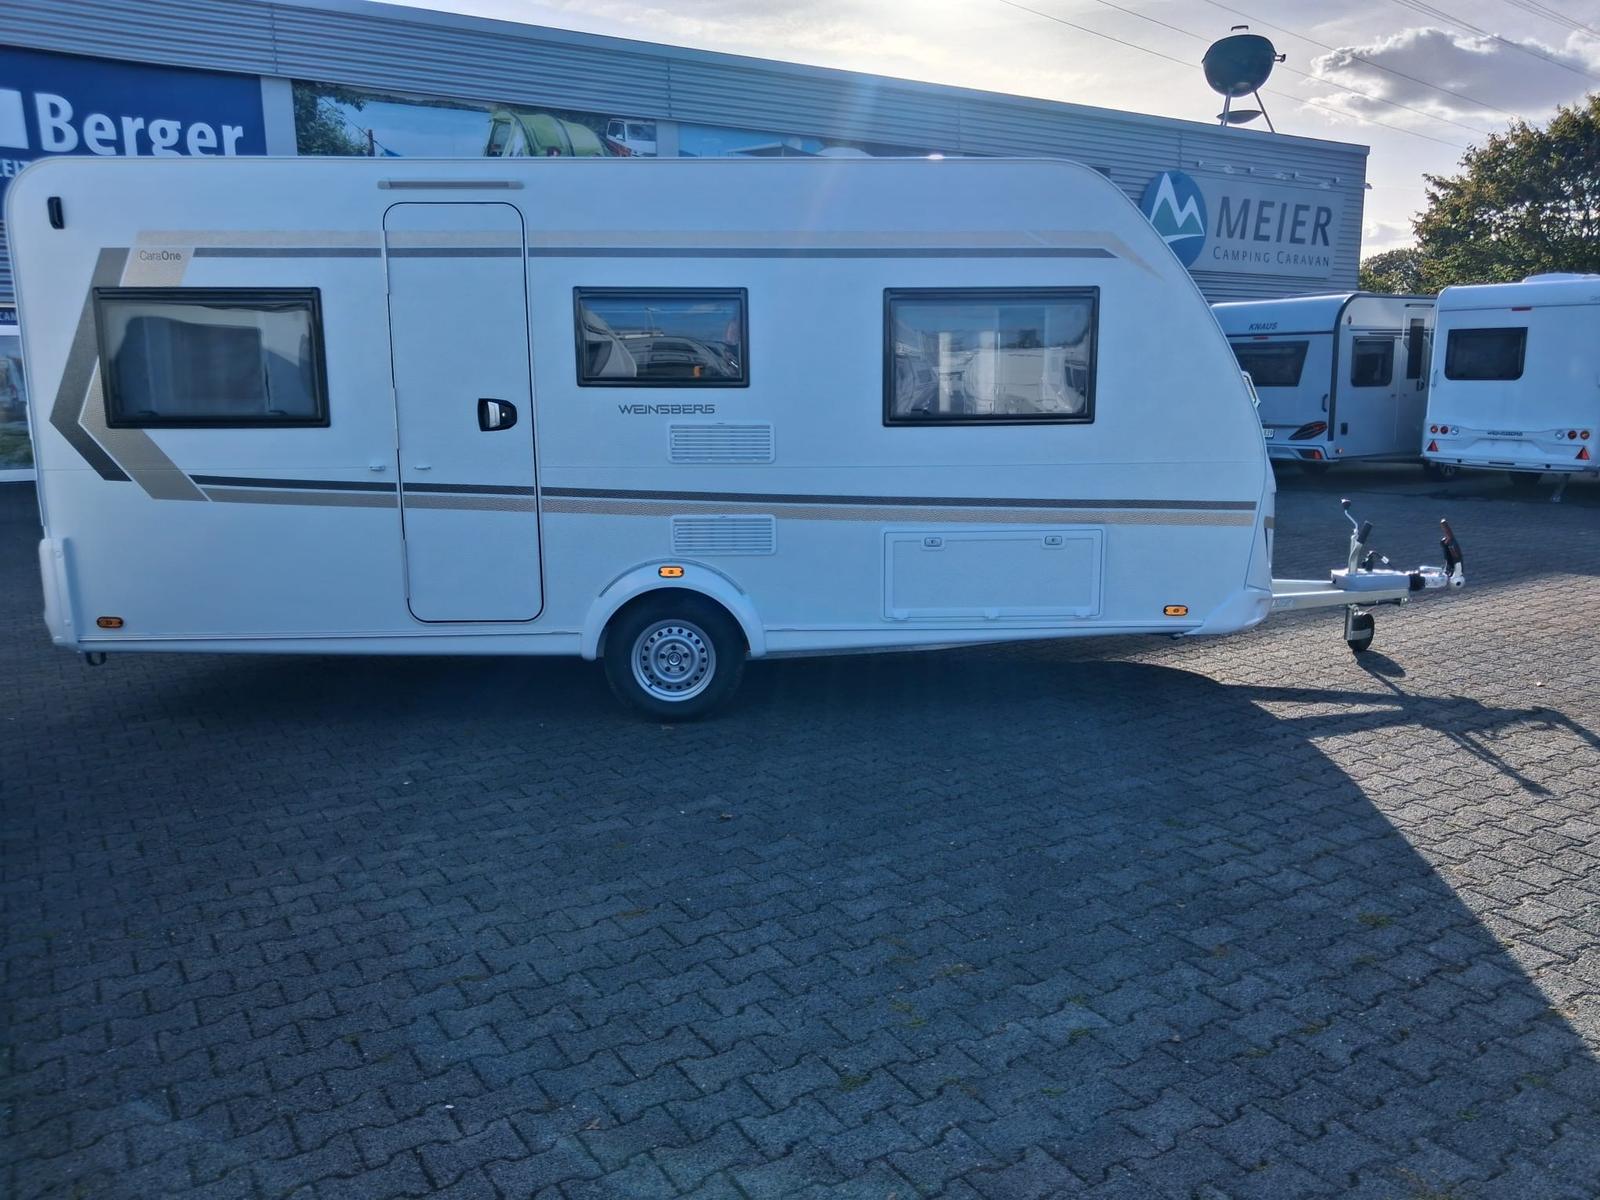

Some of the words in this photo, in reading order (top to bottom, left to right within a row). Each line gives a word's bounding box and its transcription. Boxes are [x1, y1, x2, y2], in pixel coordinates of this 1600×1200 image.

[34, 92, 244, 156] Berger
[1215, 195, 1333, 247] MEIER
[140, 250, 182, 261] CaraOne
[1213, 245, 1271, 264] CAMPING
[1276, 250, 1330, 267] CARAVAN
[1249, 321, 1278, 331] KNAUS
[618, 404, 716, 415] WEINSBERG
